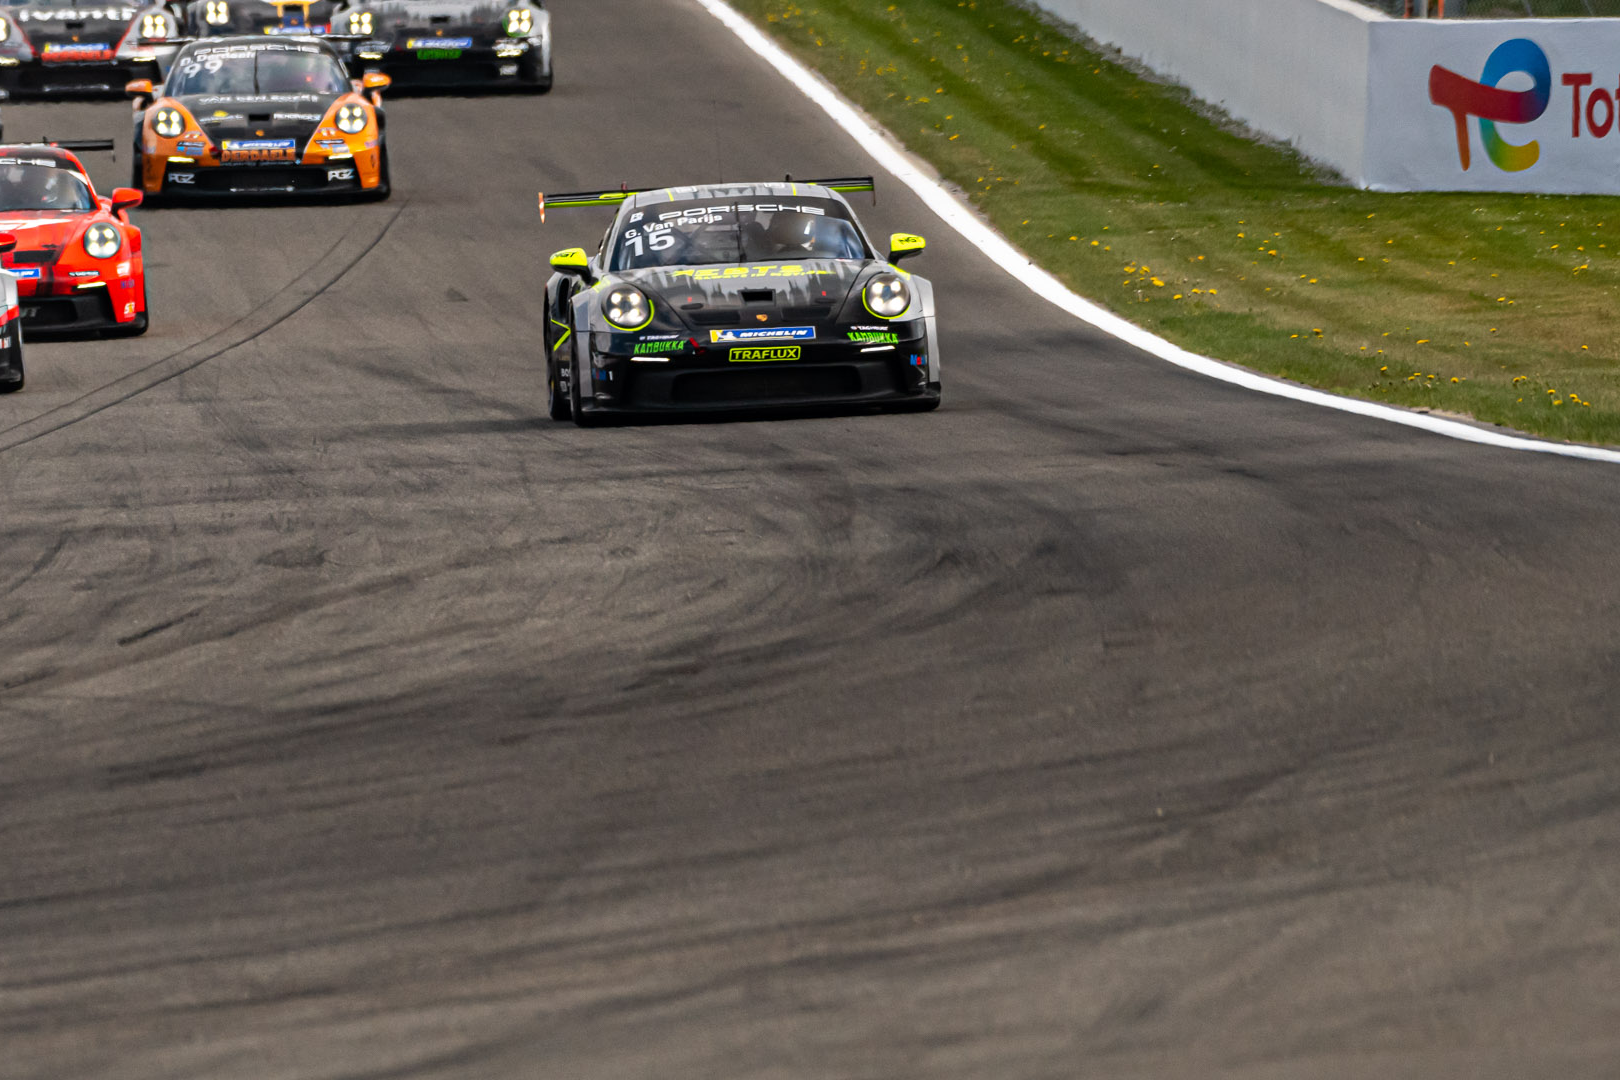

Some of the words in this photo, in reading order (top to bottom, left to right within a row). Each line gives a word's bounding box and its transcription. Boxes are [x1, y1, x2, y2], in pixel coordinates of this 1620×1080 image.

[194, 44, 320, 56] PORSCHE
[183, 60, 223, 78] 99
[221, 148, 296, 162] DERDAELE
[658, 204, 825, 221] PORSCHE
[625, 230, 641, 239] G.
[643, 221, 674, 233] Van
[677, 213, 723, 226] Parijs
[625, 228, 675, 257] 15
[739, 329, 808, 338] MICHELIN
[847, 331, 900, 344] KAMBUKKA
[633, 340, 685, 355] KAMBUKKA
[733, 347, 797, 360] TRAFLUX
